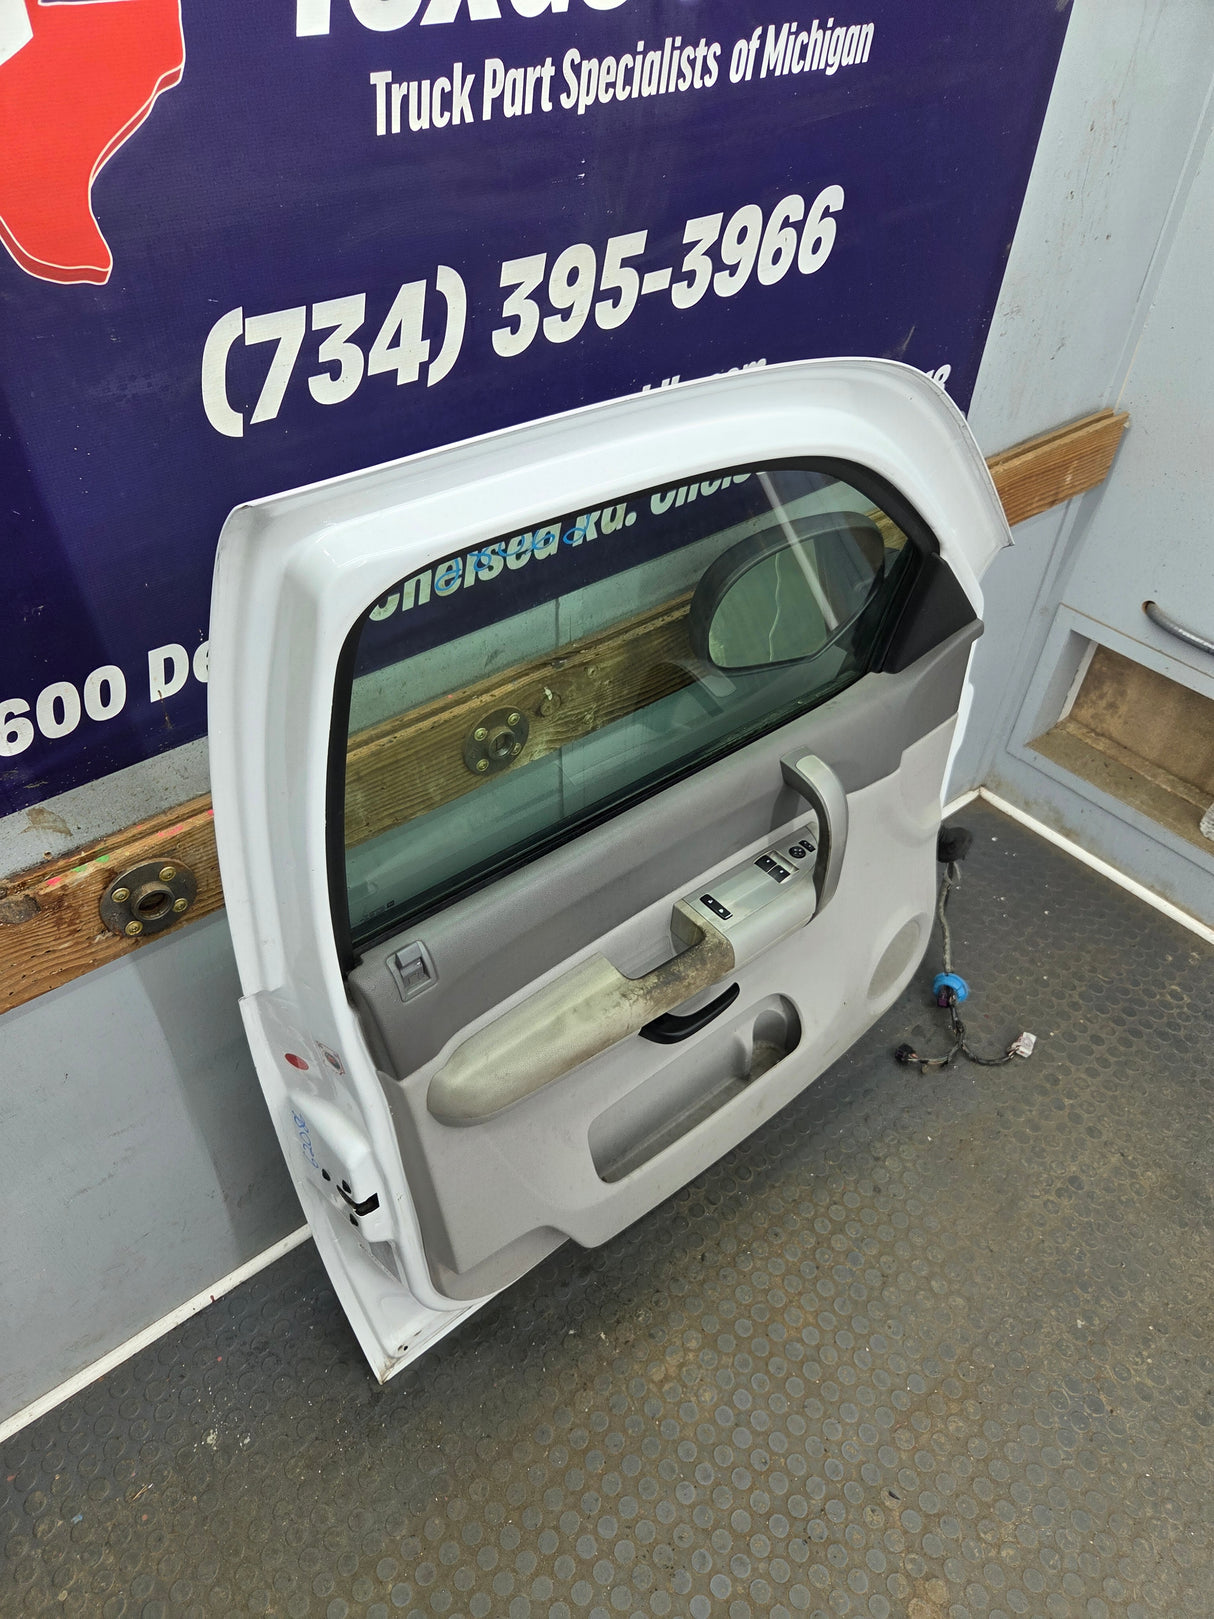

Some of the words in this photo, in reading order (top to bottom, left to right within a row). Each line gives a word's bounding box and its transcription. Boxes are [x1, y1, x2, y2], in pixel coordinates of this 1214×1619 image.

[370, 61, 476, 137] Truck
[483, 57, 556, 121] Part
[560, 36, 721, 116] Specialists
[730, 27, 762, 84] of
[760, 17, 875, 79] Michigan
[201, 264, 467, 438] (734)
[491, 184, 845, 358] 395-3966
